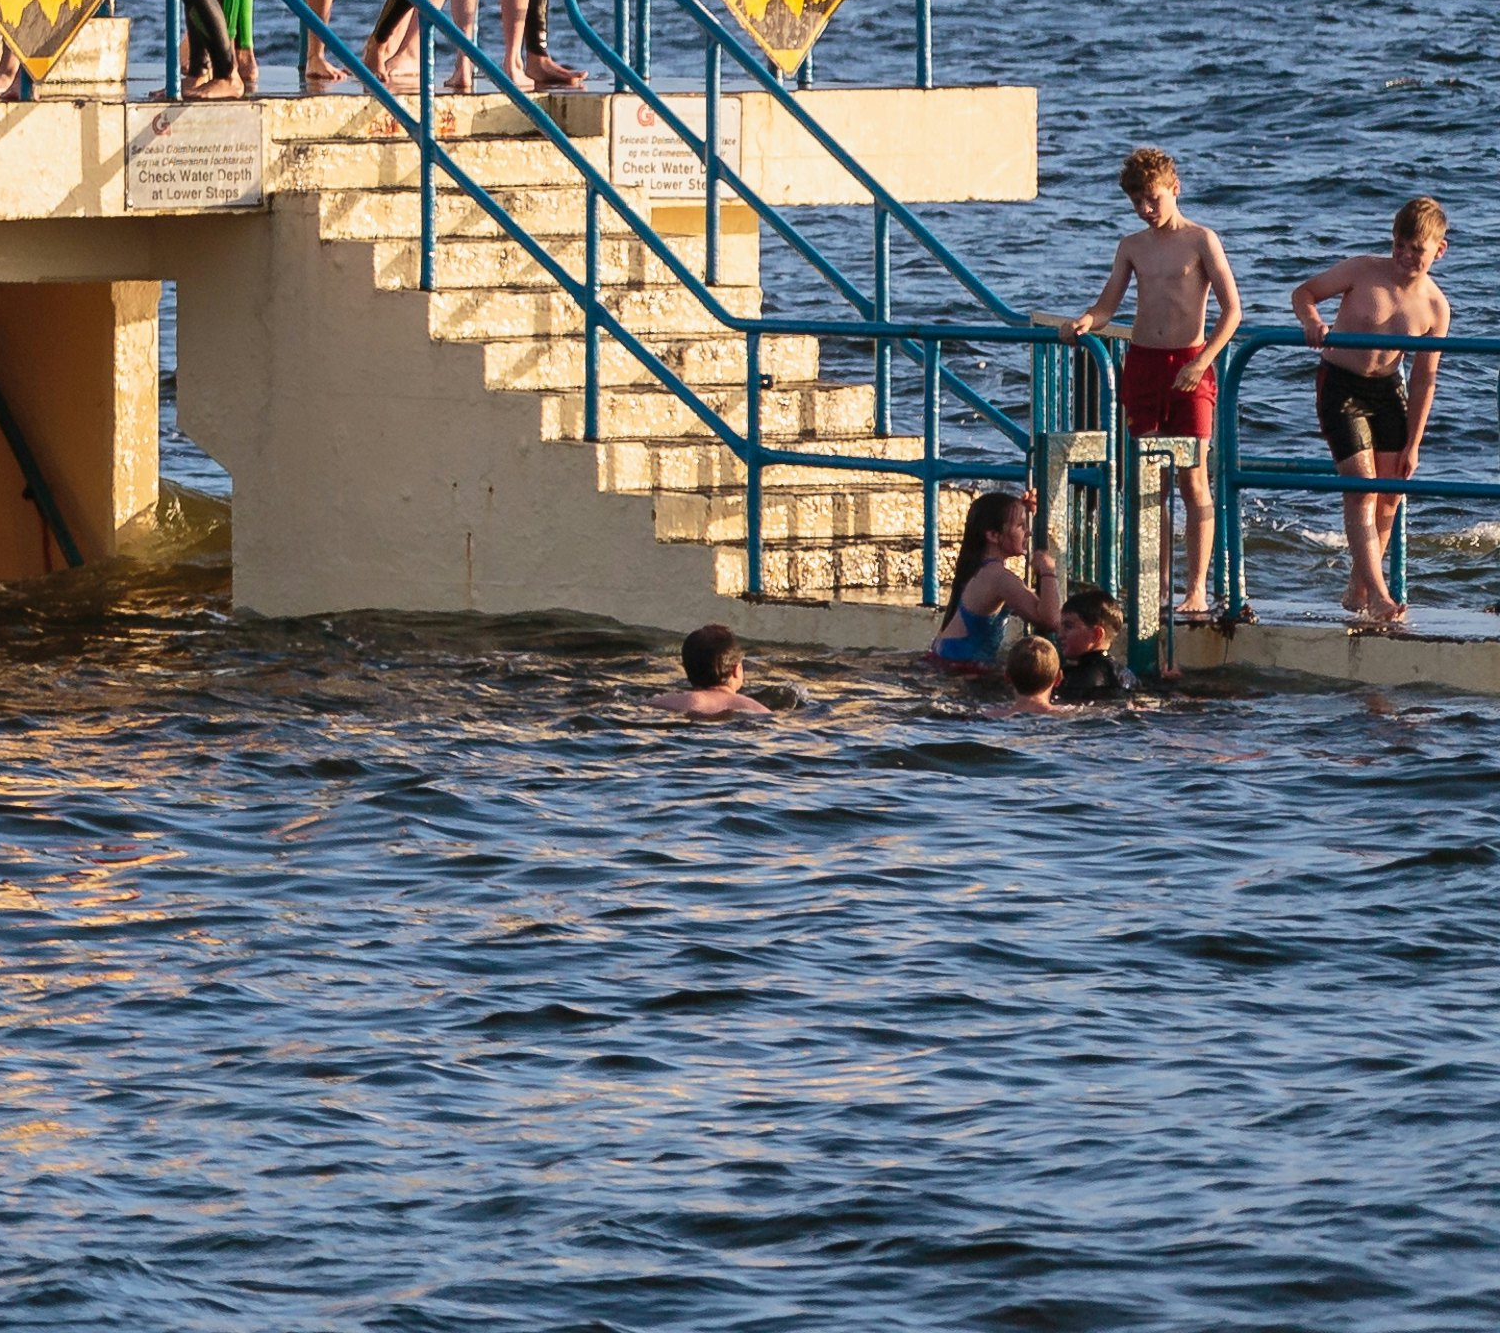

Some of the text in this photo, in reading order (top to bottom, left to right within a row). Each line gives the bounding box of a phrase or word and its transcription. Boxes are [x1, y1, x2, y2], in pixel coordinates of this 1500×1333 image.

[622, 161, 656, 174] Check
[661, 162, 694, 174] Water
[138, 168, 252, 184] Check Water Depth
[650, 178, 682, 190] Lower
[688, 178, 707, 191] Ste
[152, 186, 240, 203] at Lower Steps
